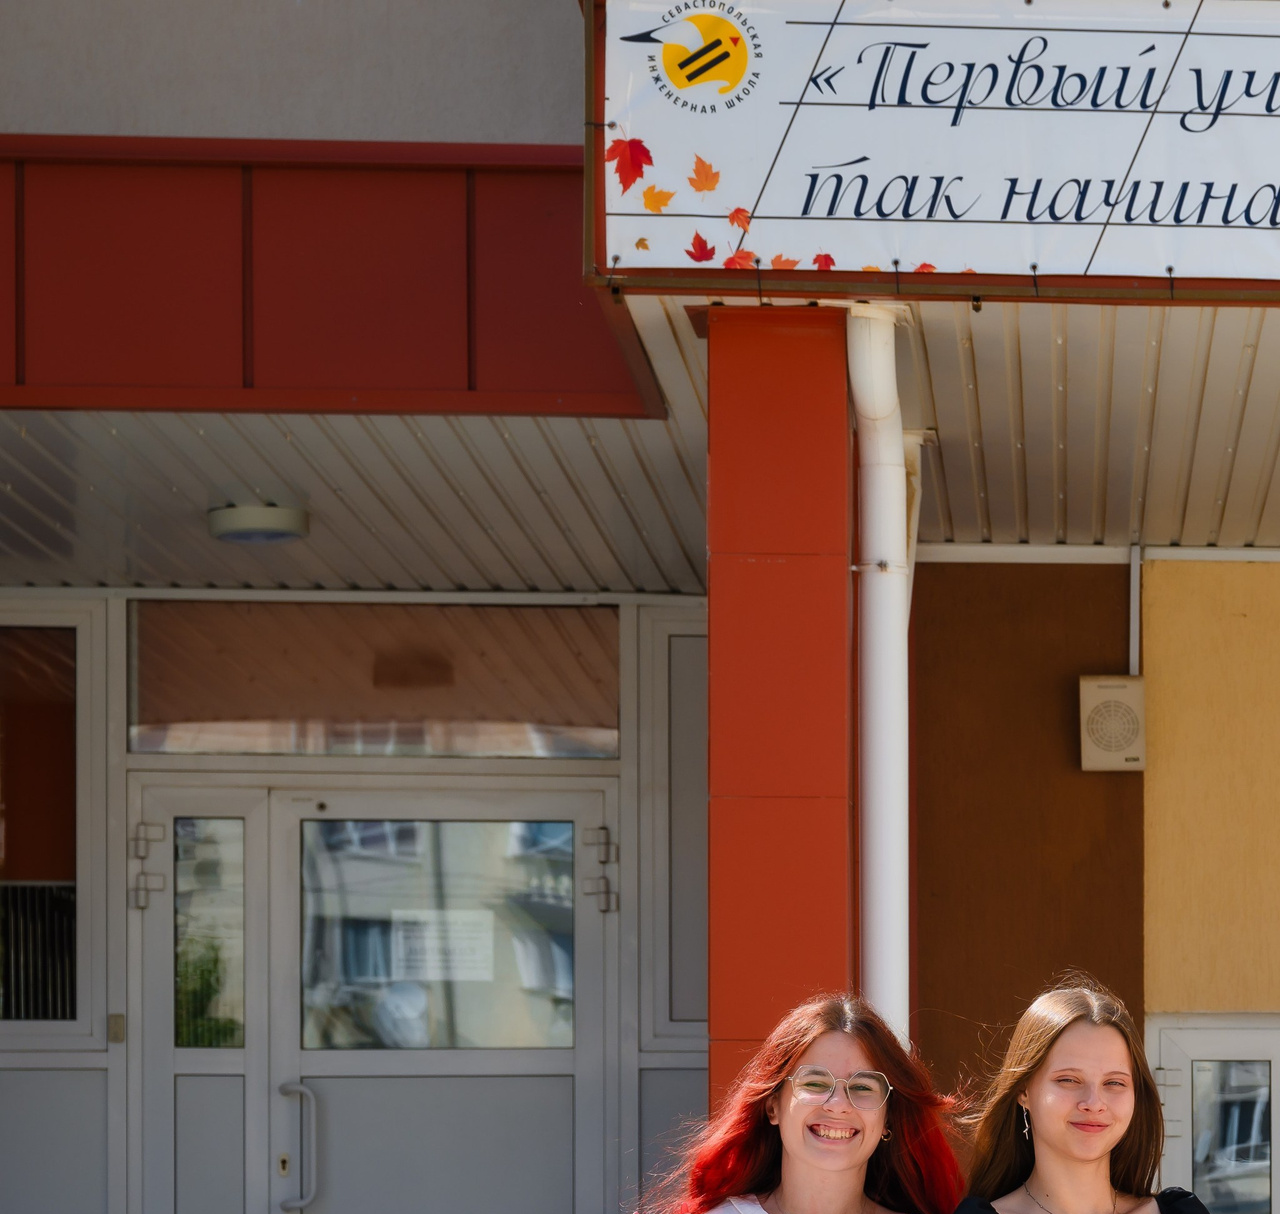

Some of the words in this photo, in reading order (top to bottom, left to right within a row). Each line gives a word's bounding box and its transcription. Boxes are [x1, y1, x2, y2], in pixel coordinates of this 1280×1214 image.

[661, 0, 764, 59] СЕВАСТОПОЛЬСКАЯ
[646, 54, 717, 114] ИНЖЕНЕРНАЯ
[725, 71, 761, 110] ШКОЛА
[799, 155, 982, 220] так
